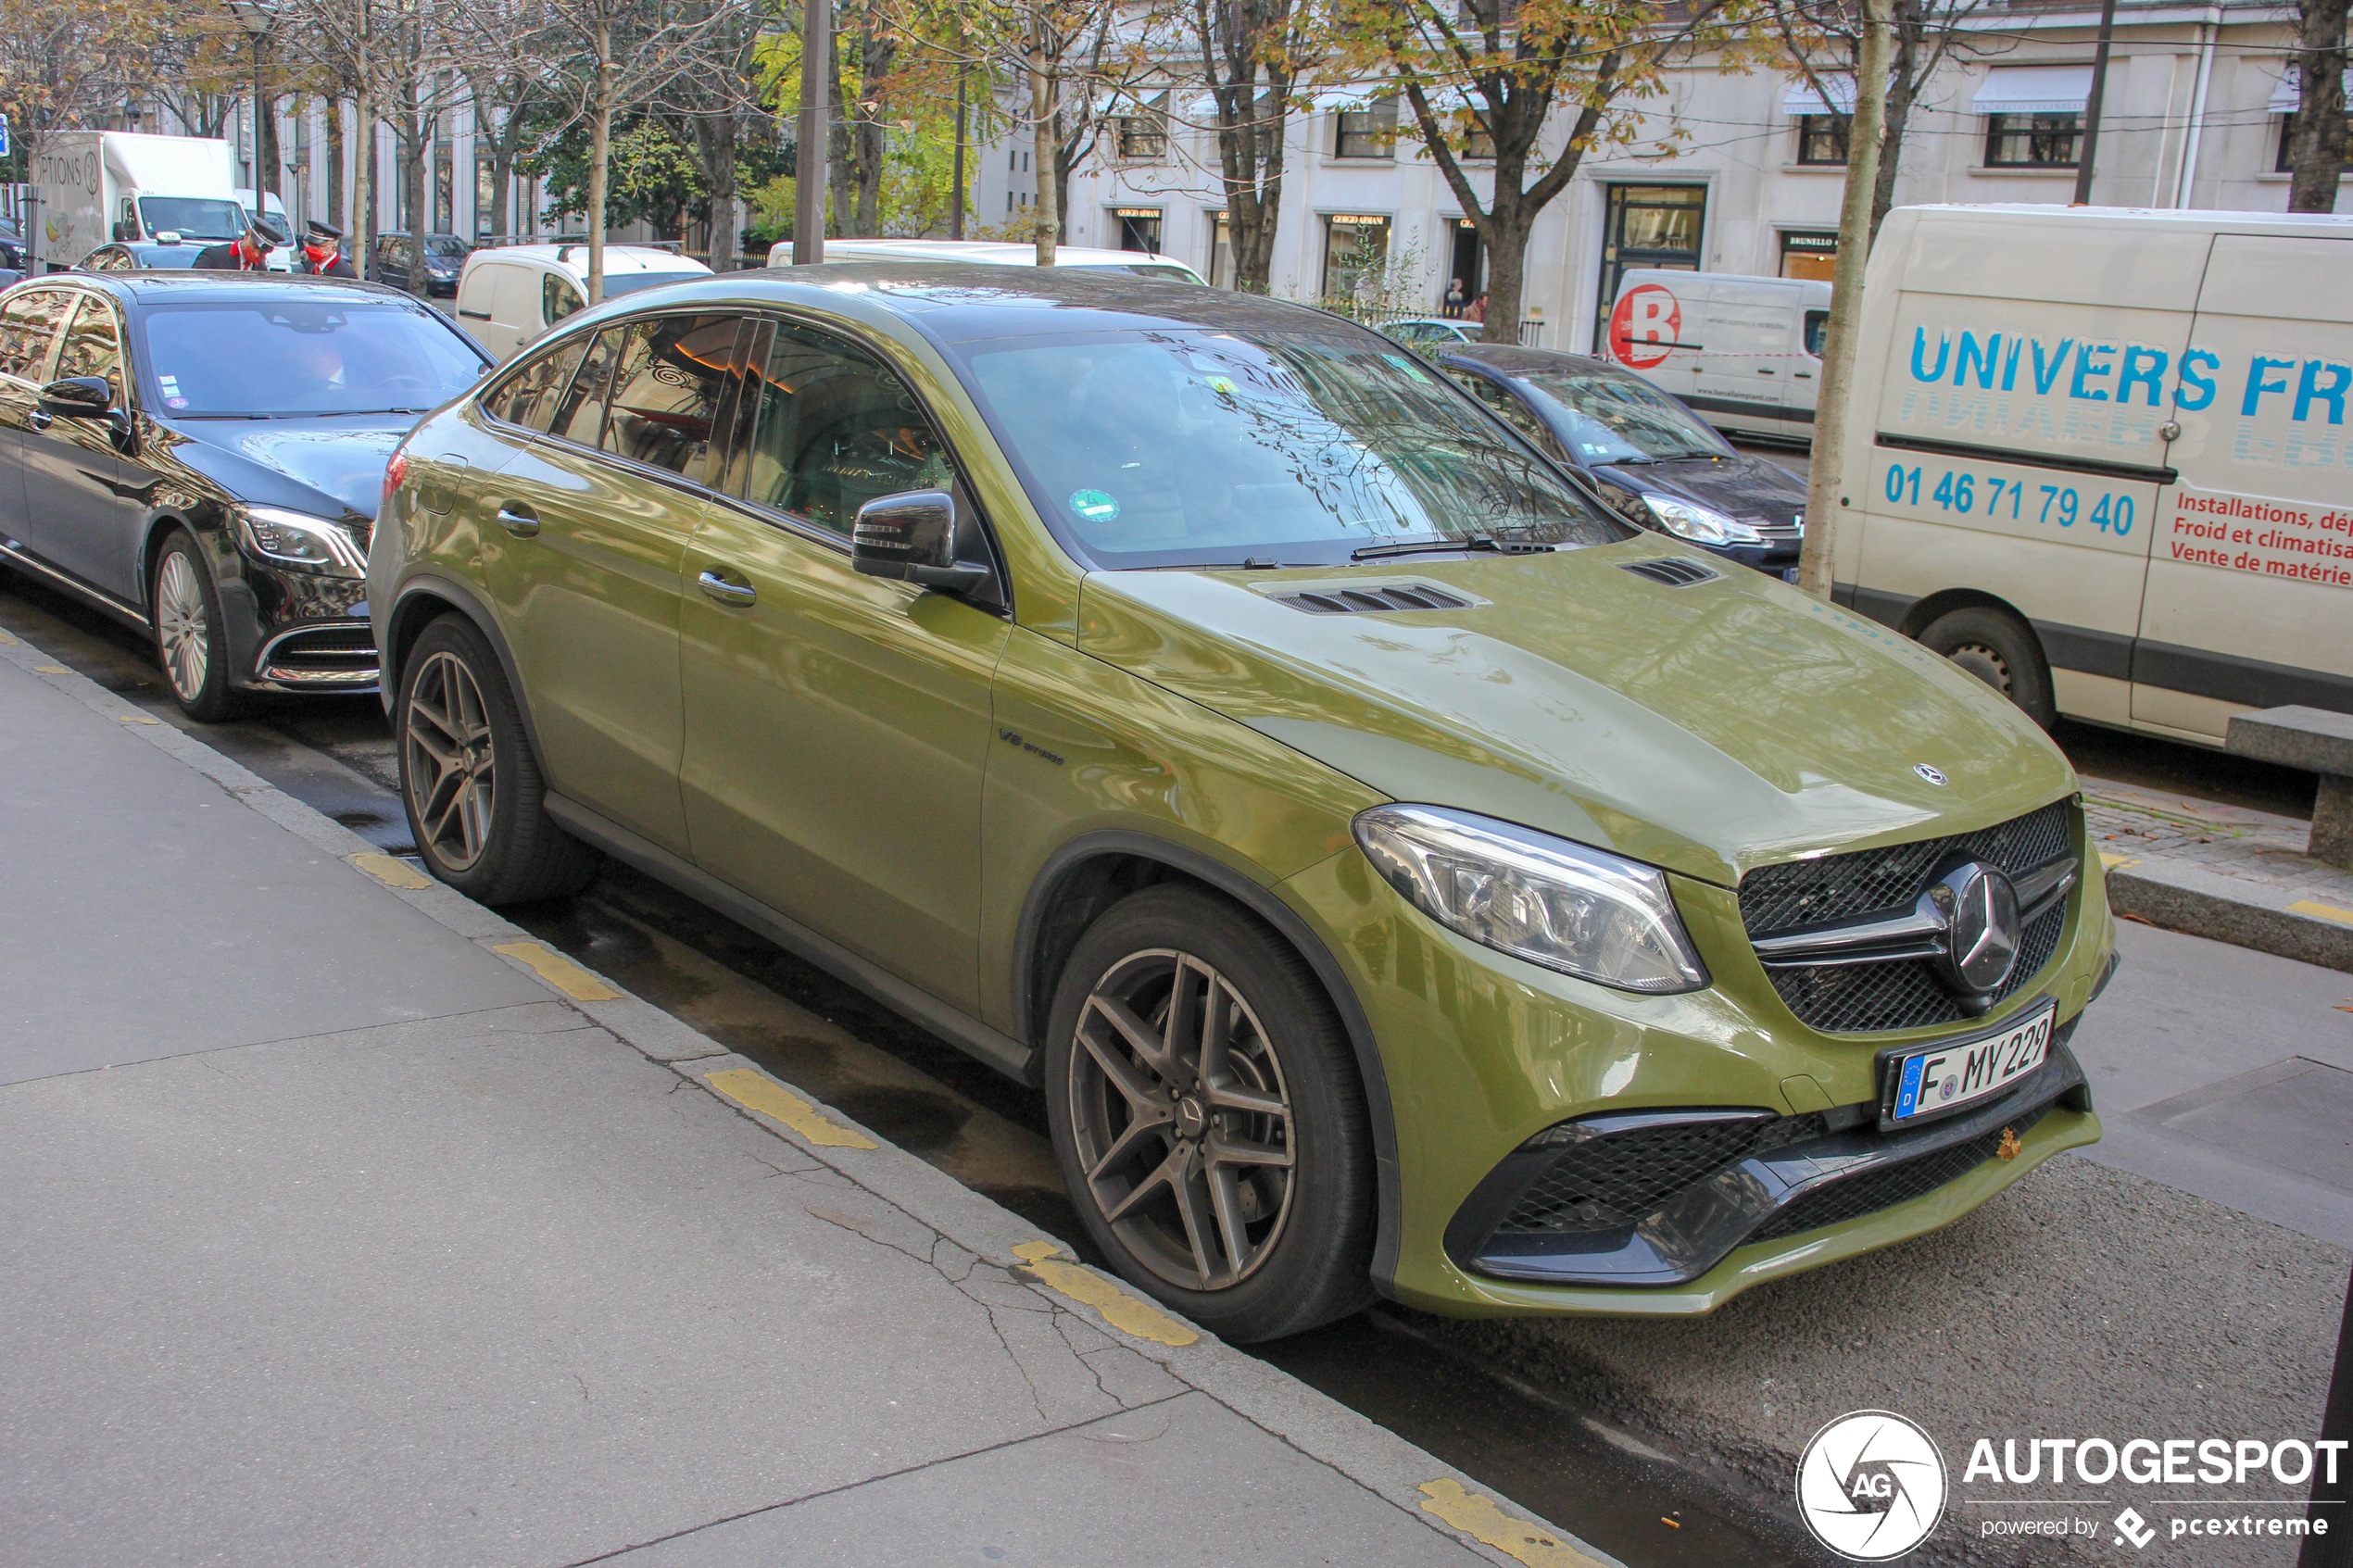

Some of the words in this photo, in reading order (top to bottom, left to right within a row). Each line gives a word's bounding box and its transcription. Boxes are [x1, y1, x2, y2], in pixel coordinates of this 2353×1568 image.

[1332, 215, 1359, 224] GIORGIO
[1359, 215, 1384, 225] ARMANI
[1789, 236, 1833, 246] BRUNELLO
[1909, 324, 2221, 411] UNIVERS
[2240, 348, 2353, 425] FR
[1885, 464, 1922, 506] 01
[1932, 470, 1975, 513] 46
[1987, 477, 2022, 520] 71
[2040, 484, 2079, 527] 79
[2090, 493, 2134, 536] 40
[2177, 492, 2314, 530] Installations,
[2173, 517, 2228, 541] Froid
[2232, 528, 2254, 545] et
[2171, 541, 2230, 567] Vente
[2234, 552, 2261, 571] de
[2266, 560, 2353, 585] matérie
[1000, 727, 1023, 746] V8
[1023, 742, 1064, 766] BITURBO
[1919, 1057, 1946, 1106] F
[1961, 1038, 2006, 1094] MY
[2003, 1018, 2048, 1078] 229
[1903, 1092, 1913, 1107] D
